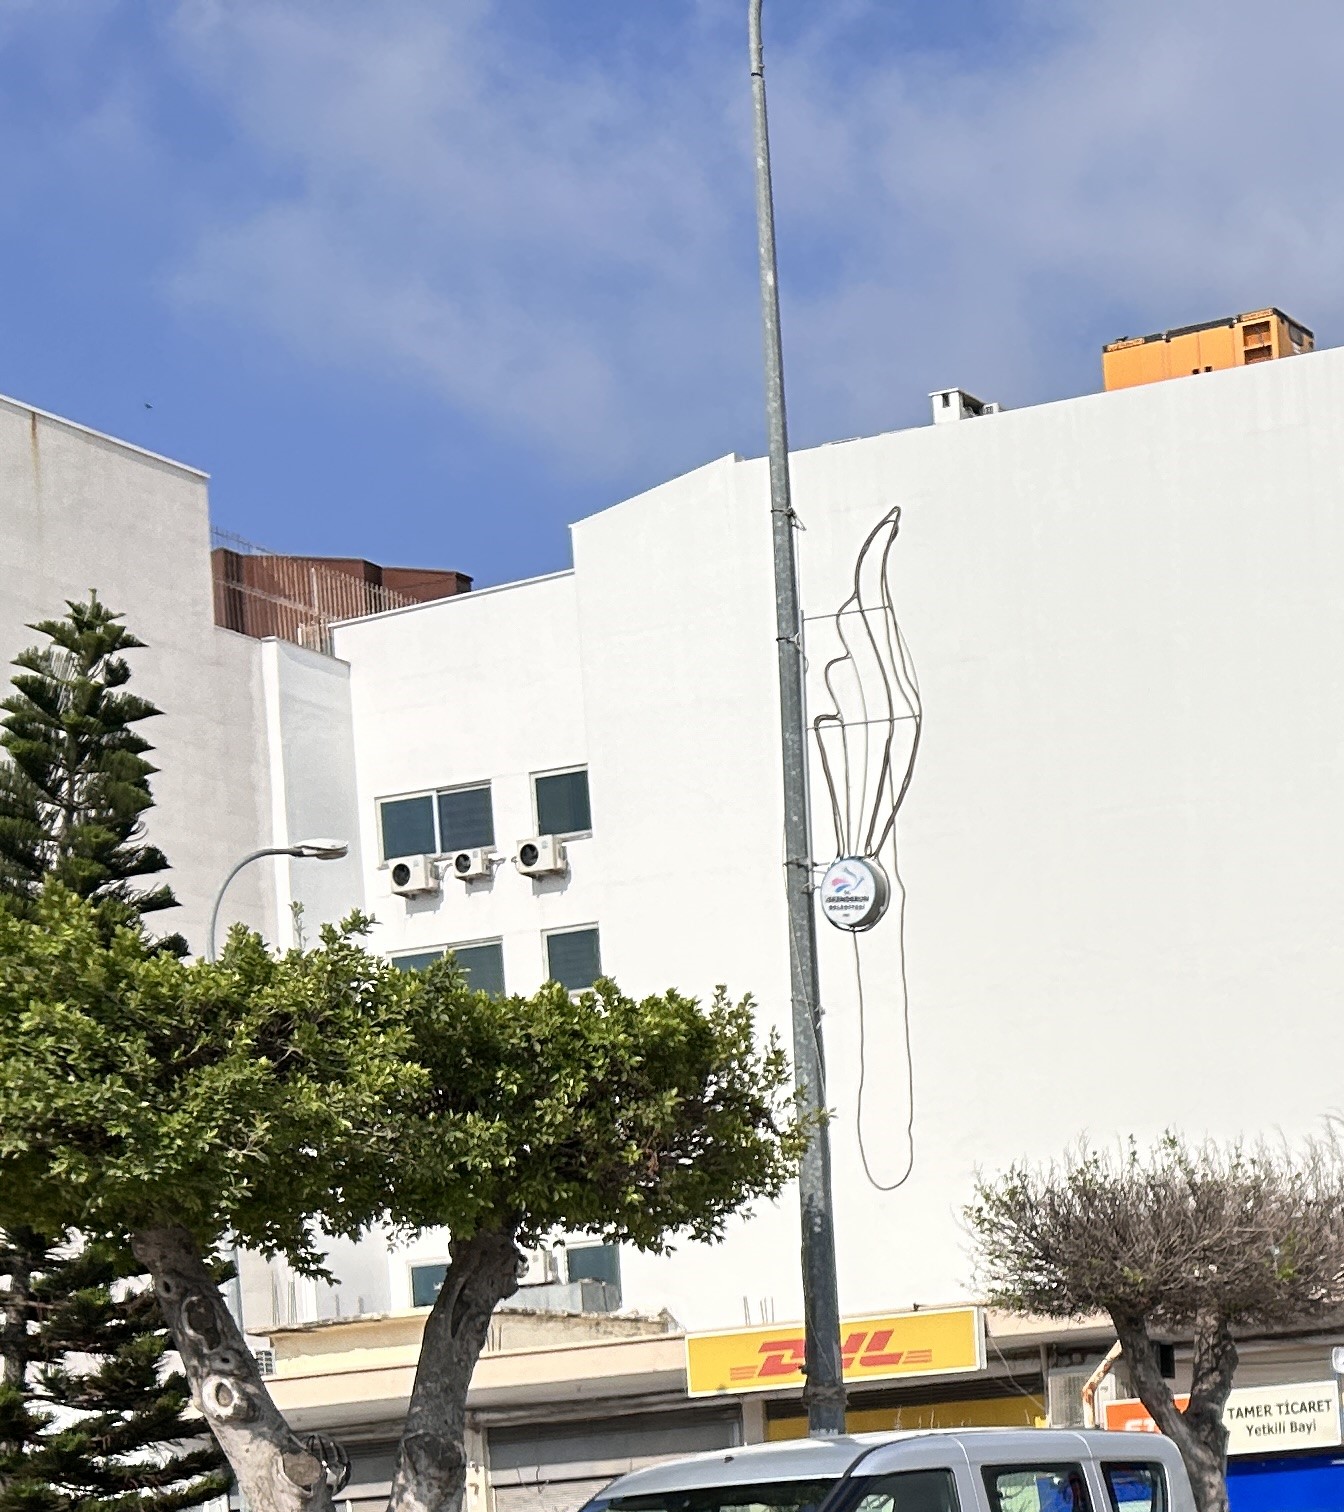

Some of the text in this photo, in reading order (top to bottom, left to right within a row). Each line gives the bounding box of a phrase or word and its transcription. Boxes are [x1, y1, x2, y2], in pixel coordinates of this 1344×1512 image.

[1227, 1398, 1333, 1420] TAMER TİCARET
[1245, 1417, 1317, 1438] Yetkili Bayi
